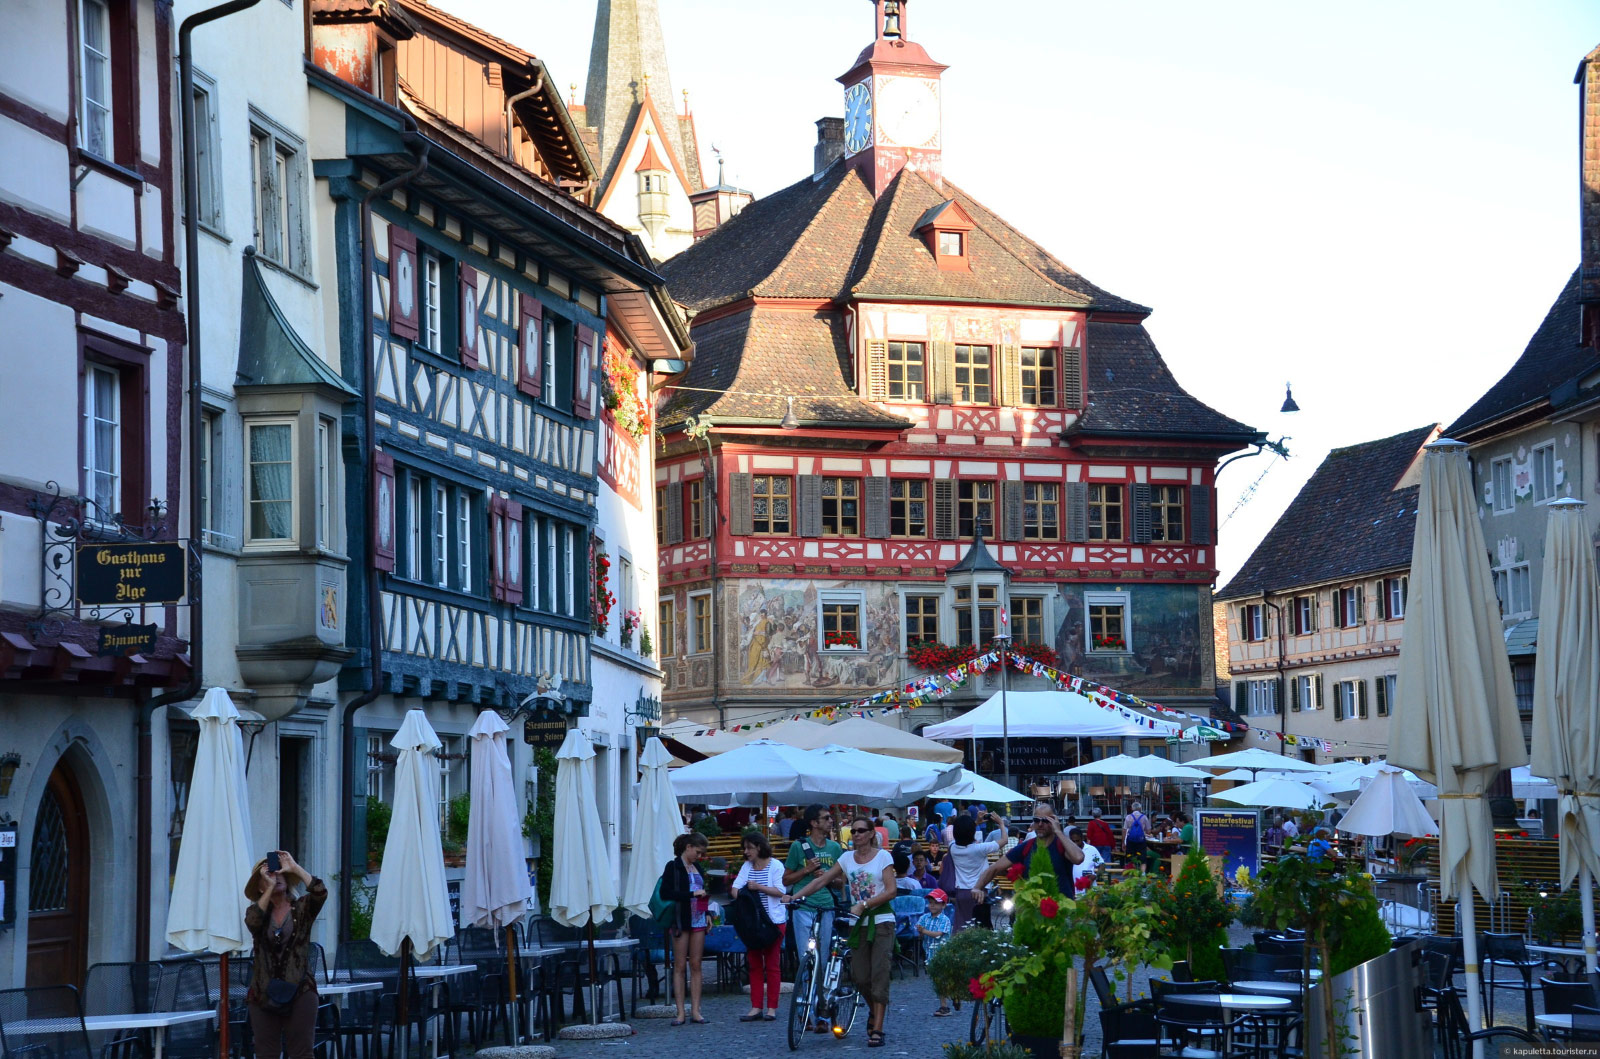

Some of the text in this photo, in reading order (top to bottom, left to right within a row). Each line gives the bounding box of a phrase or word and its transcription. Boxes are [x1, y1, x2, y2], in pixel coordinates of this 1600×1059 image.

[97, 549, 166, 566] Gasthaus
[120, 568, 142, 582] zur
[115, 583, 146, 600] Ilge
[104, 633, 150, 649] Zimmer
[526, 721, 565, 729] Restaurant
[1202, 816, 1254, 825] Theaterfestival
